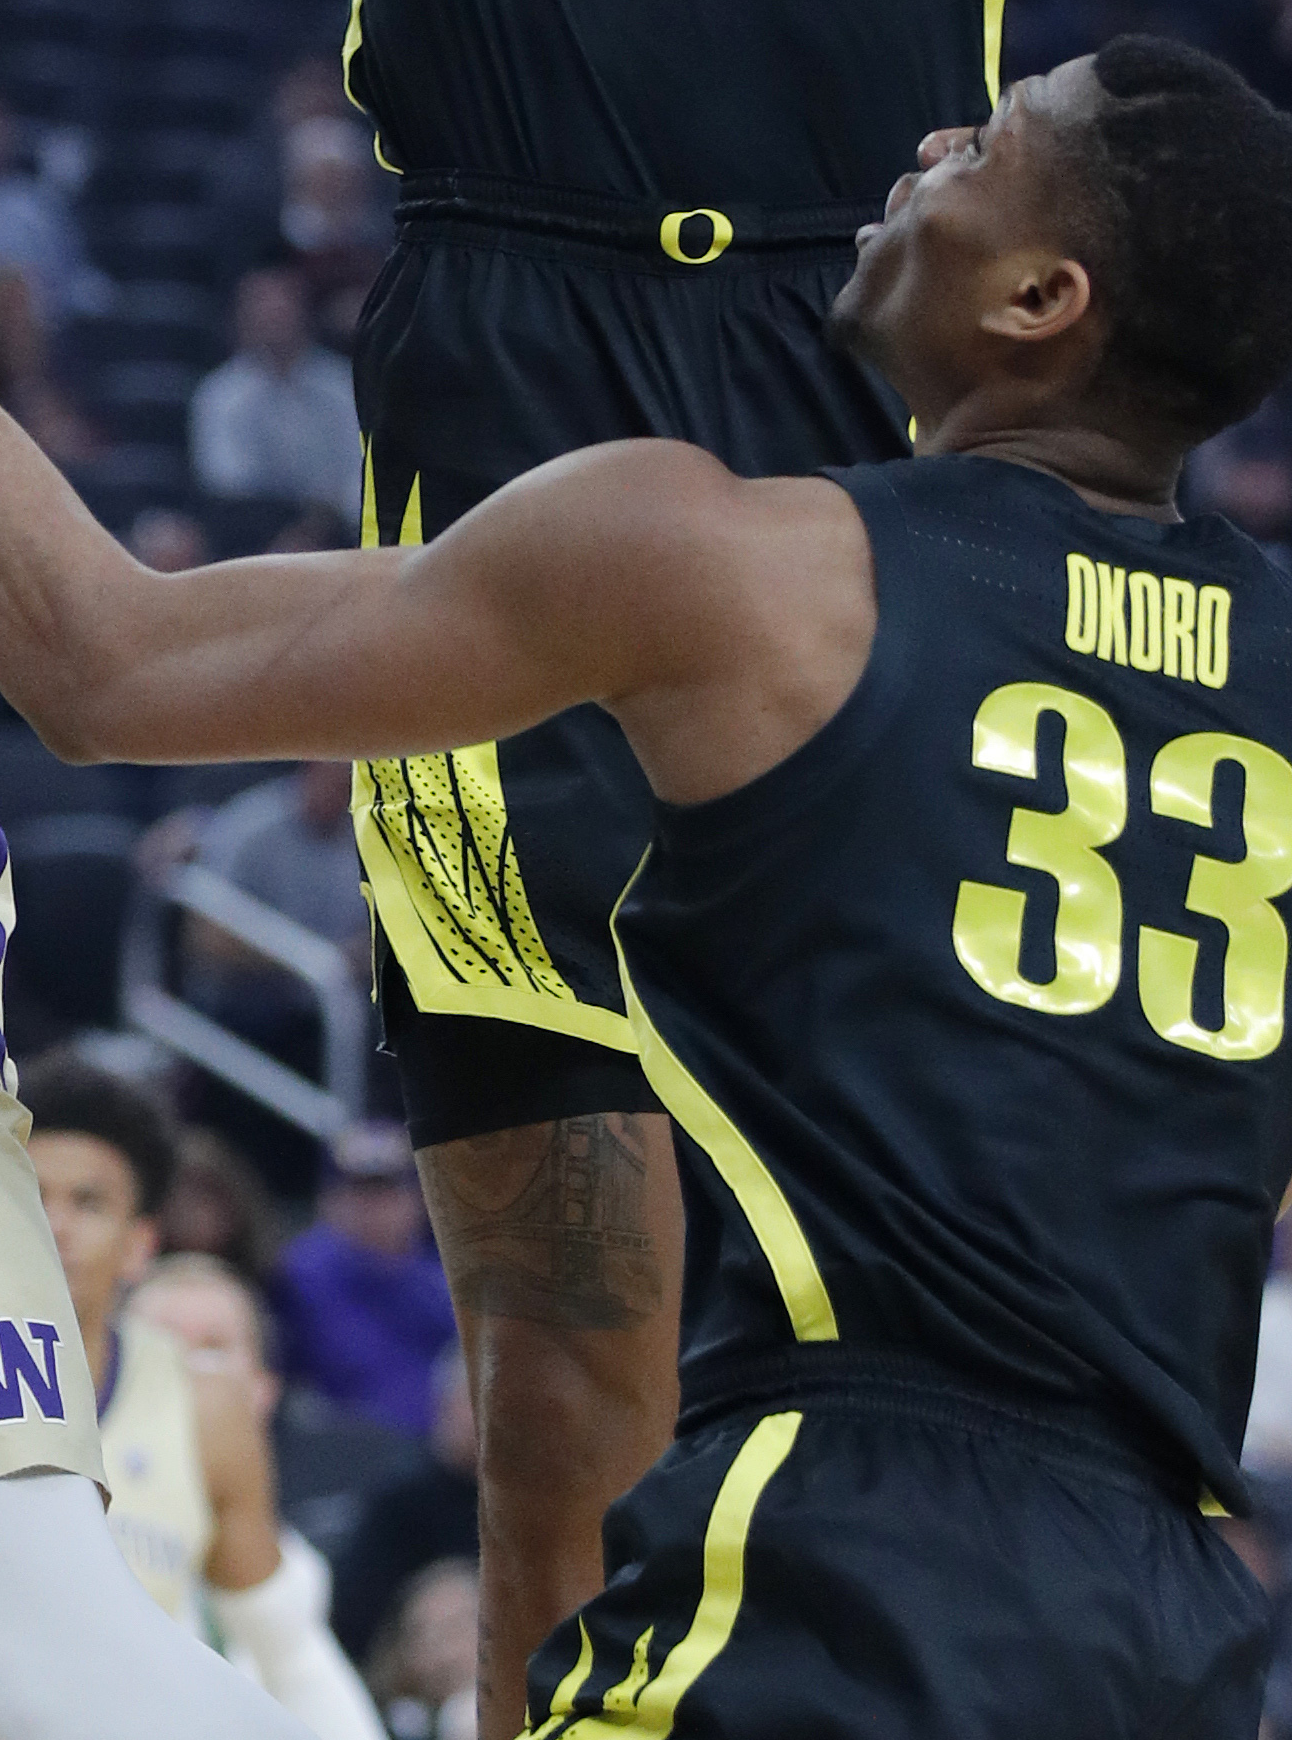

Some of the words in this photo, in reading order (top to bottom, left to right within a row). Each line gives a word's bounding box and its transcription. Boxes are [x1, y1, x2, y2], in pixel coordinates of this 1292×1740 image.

[659, 207, 735, 264] O
[1064, 552, 1232, 690] OKORO
[952, 681, 1292, 1062] 33
